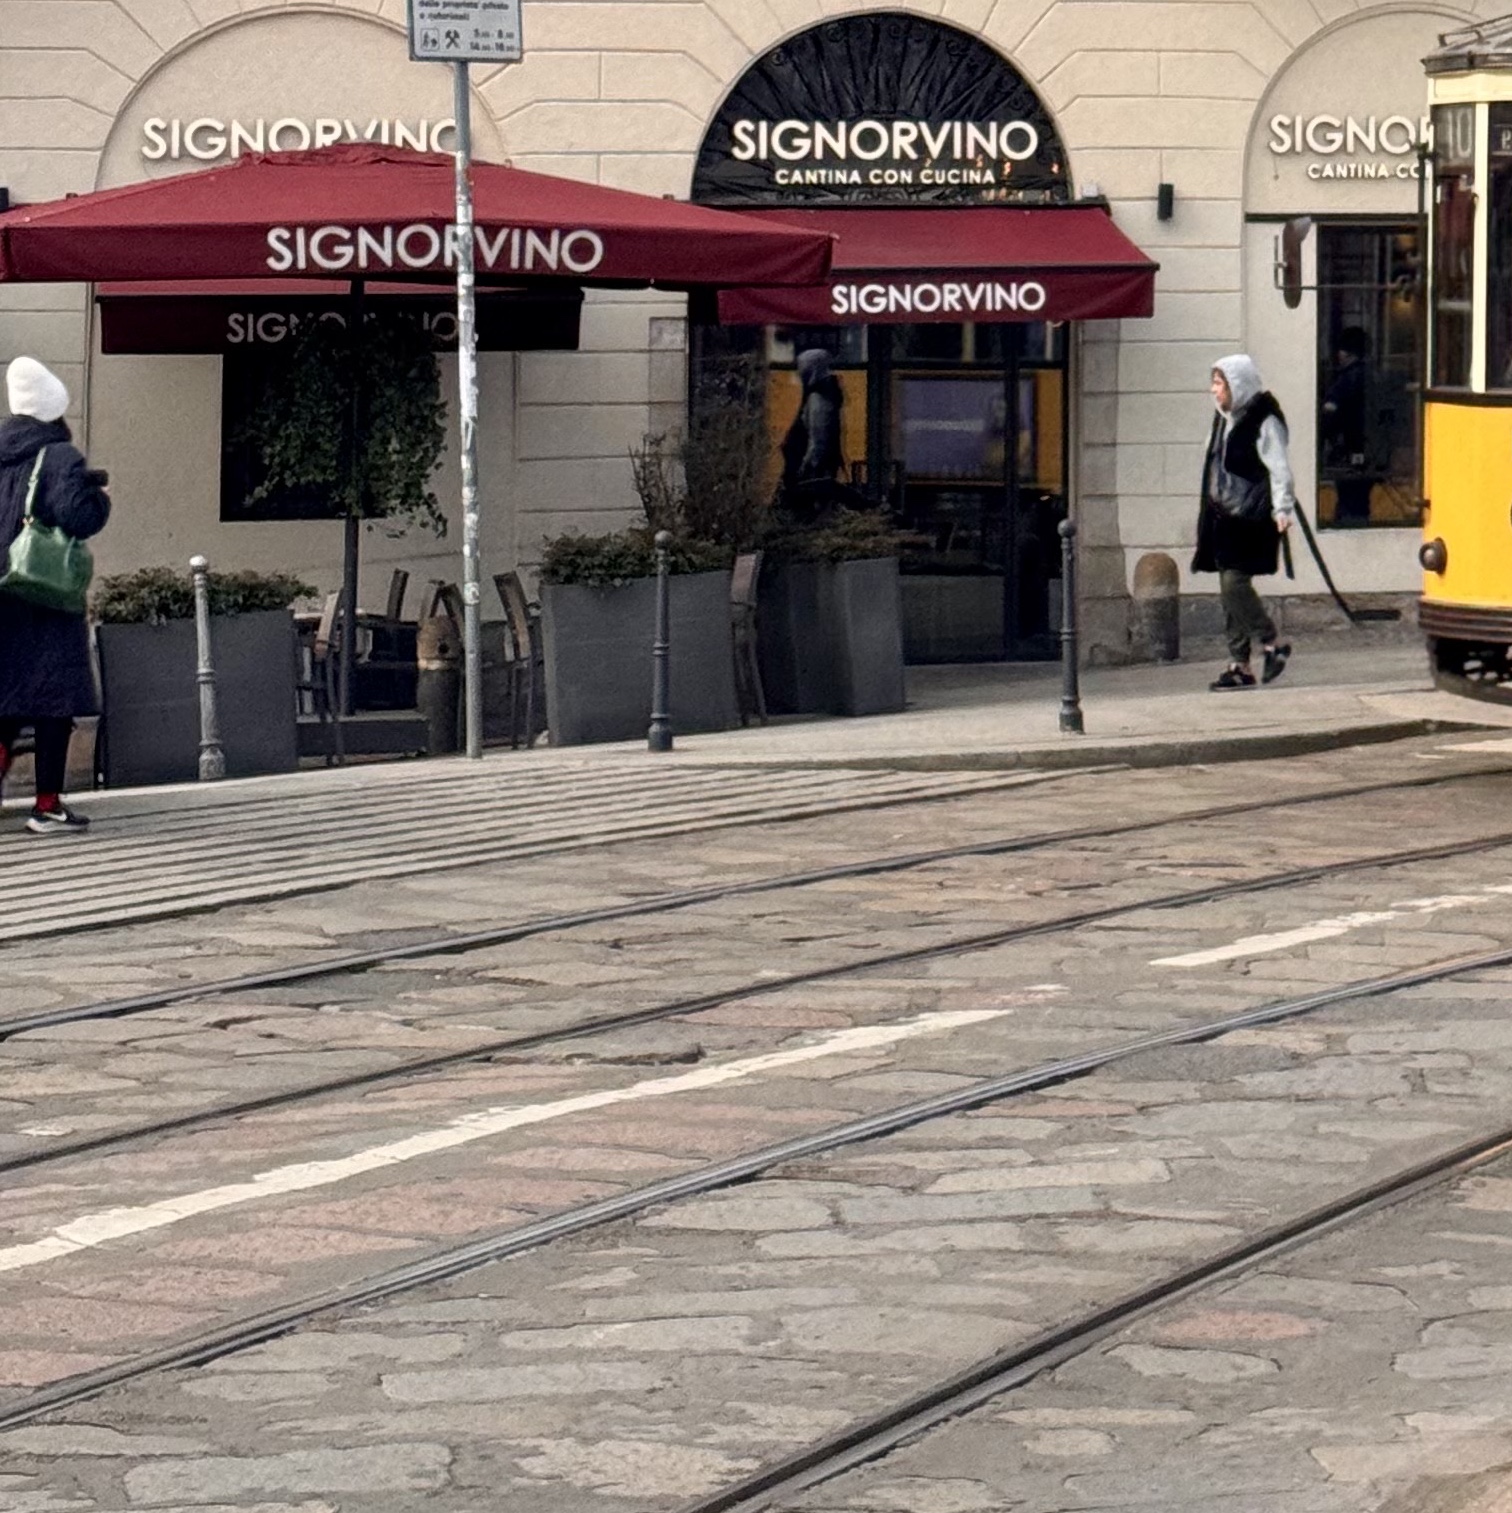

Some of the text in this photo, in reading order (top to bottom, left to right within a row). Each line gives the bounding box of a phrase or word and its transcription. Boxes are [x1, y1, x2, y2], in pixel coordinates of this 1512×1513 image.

[731, 119, 1039, 161] SIGNORVINO
[774, 168, 996, 185] CANTINA CON CUCINA
[1307, 163, 1390, 179] CANTINA
[830, 281, 1047, 315] SIGNORVINO
